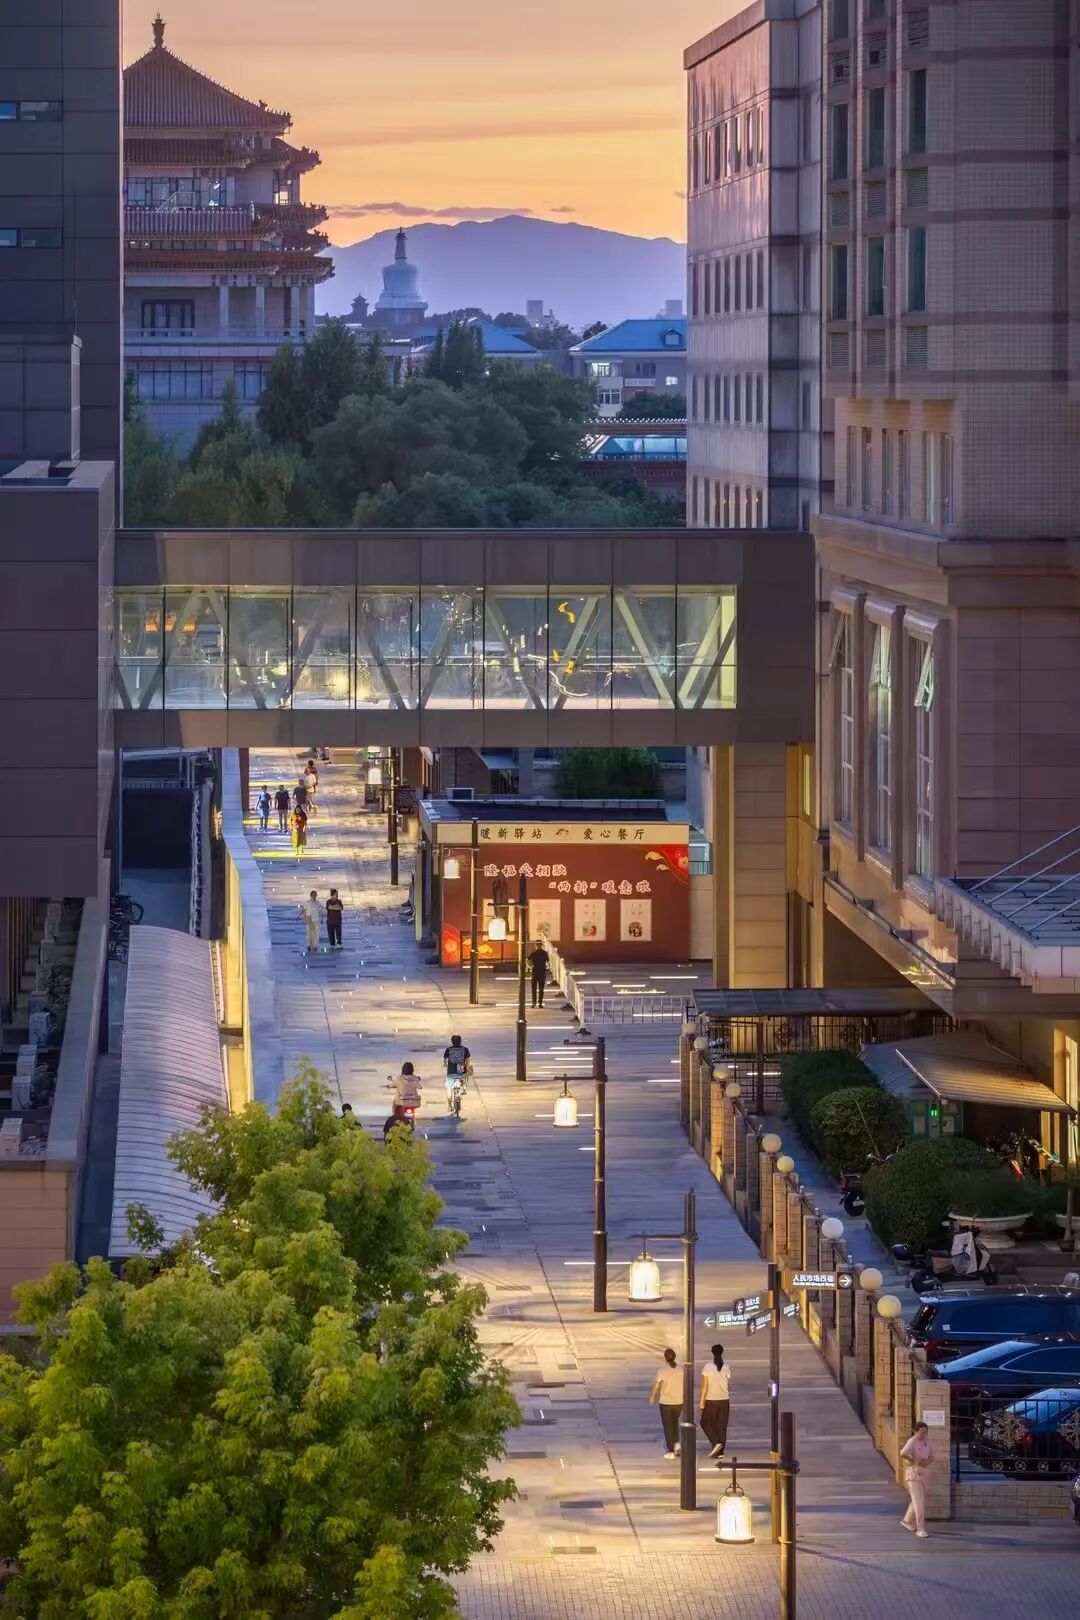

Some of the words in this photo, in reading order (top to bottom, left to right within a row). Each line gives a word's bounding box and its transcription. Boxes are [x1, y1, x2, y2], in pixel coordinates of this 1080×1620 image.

[480, 827, 542, 840] 暖新驿站
[583, 827, 645, 840] 爱心餐厅
